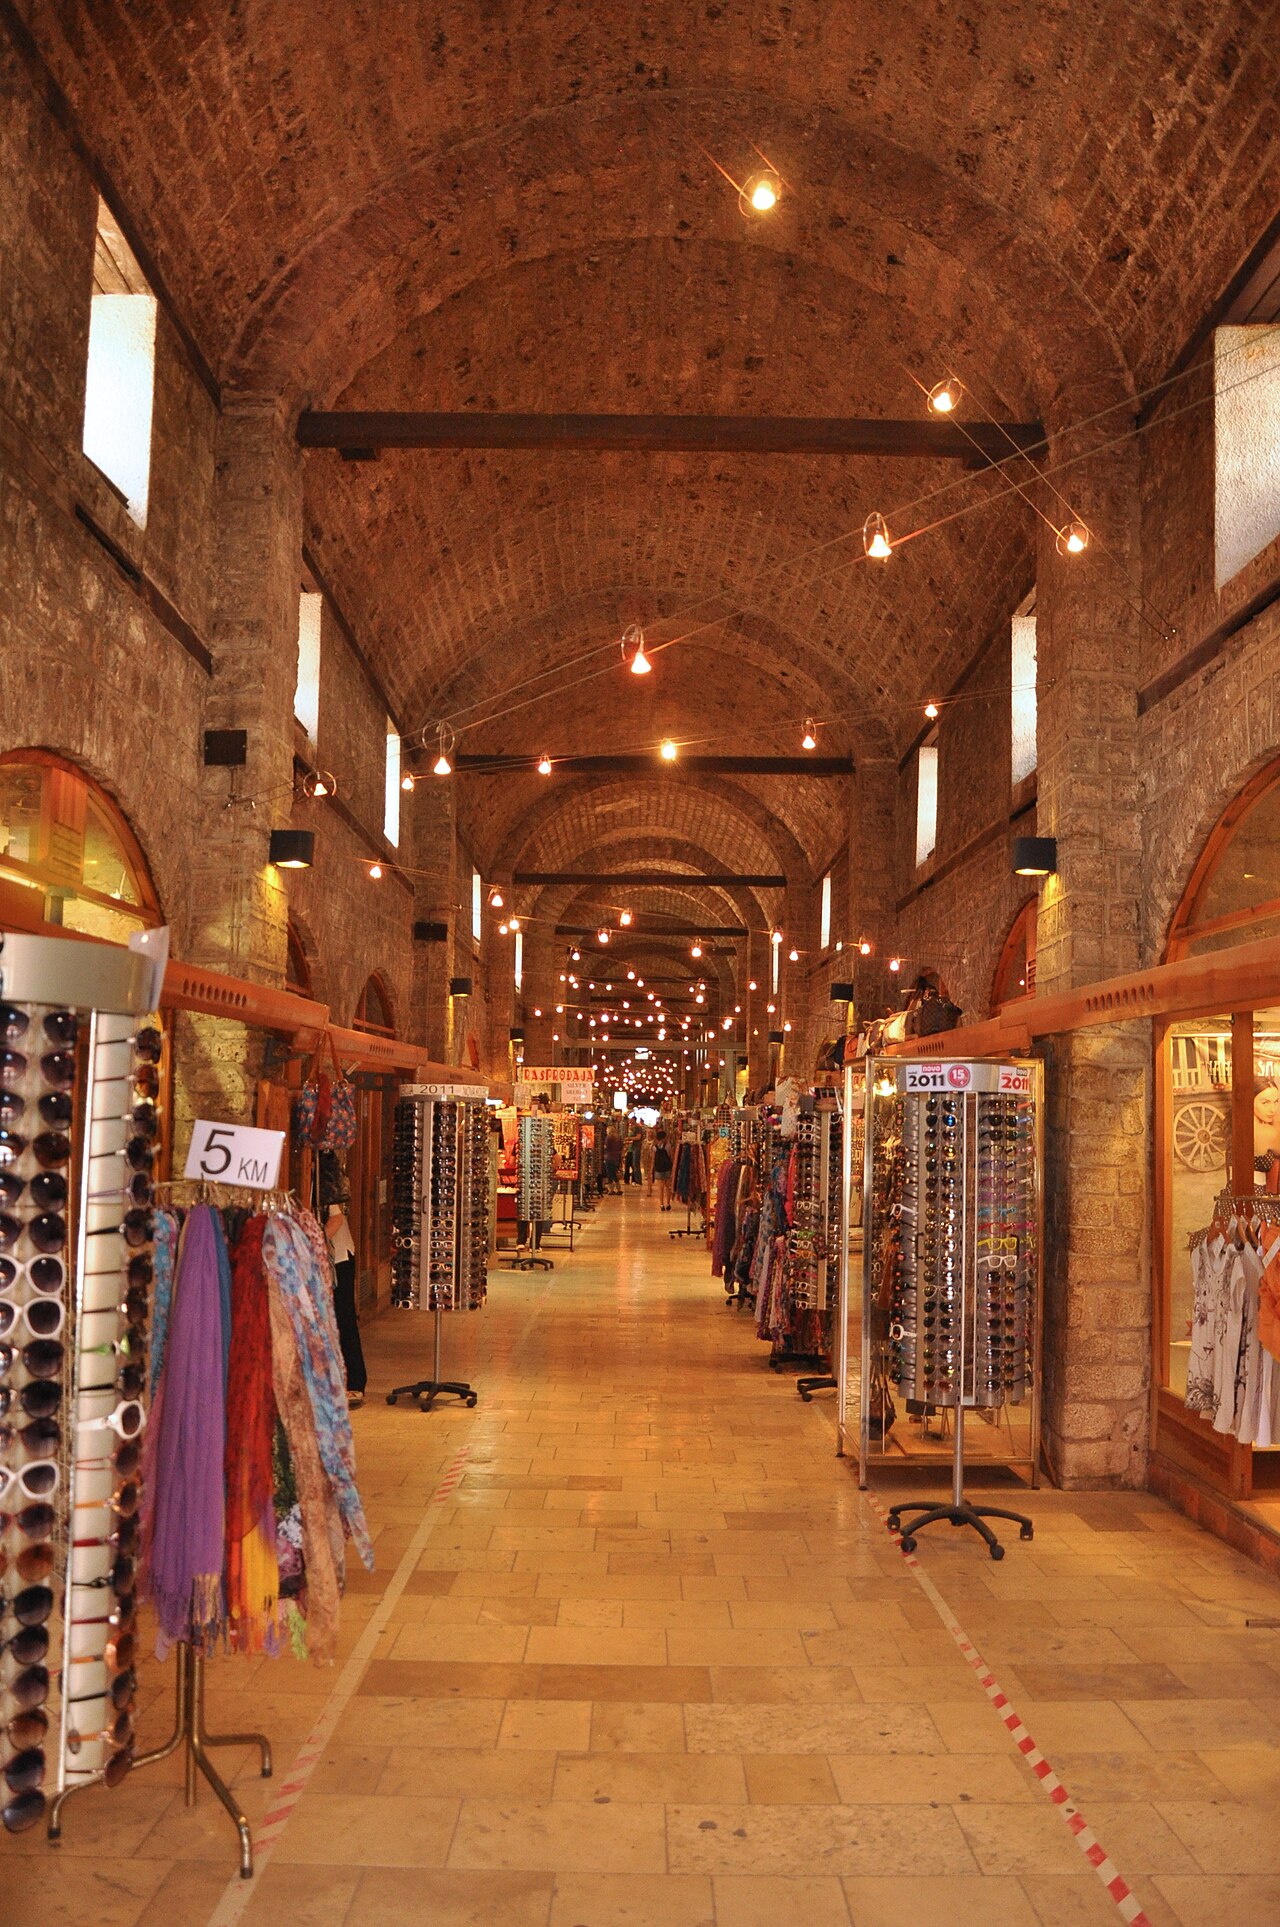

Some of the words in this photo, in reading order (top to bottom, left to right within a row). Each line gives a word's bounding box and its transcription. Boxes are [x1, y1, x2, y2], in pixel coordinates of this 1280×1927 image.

[523, 1068, 594, 1081] RASPRODAJA
[909, 1074, 945, 1087] 2011
[952, 1069, 965, 1079] 15
[420, 1085, 455, 1094] 2011
[1001, 1076, 1029, 1090] 2011
[720, 1129, 727, 1138] 5
[200, 1129, 235, 1175] 5
[237, 1157, 268, 1183] KM
